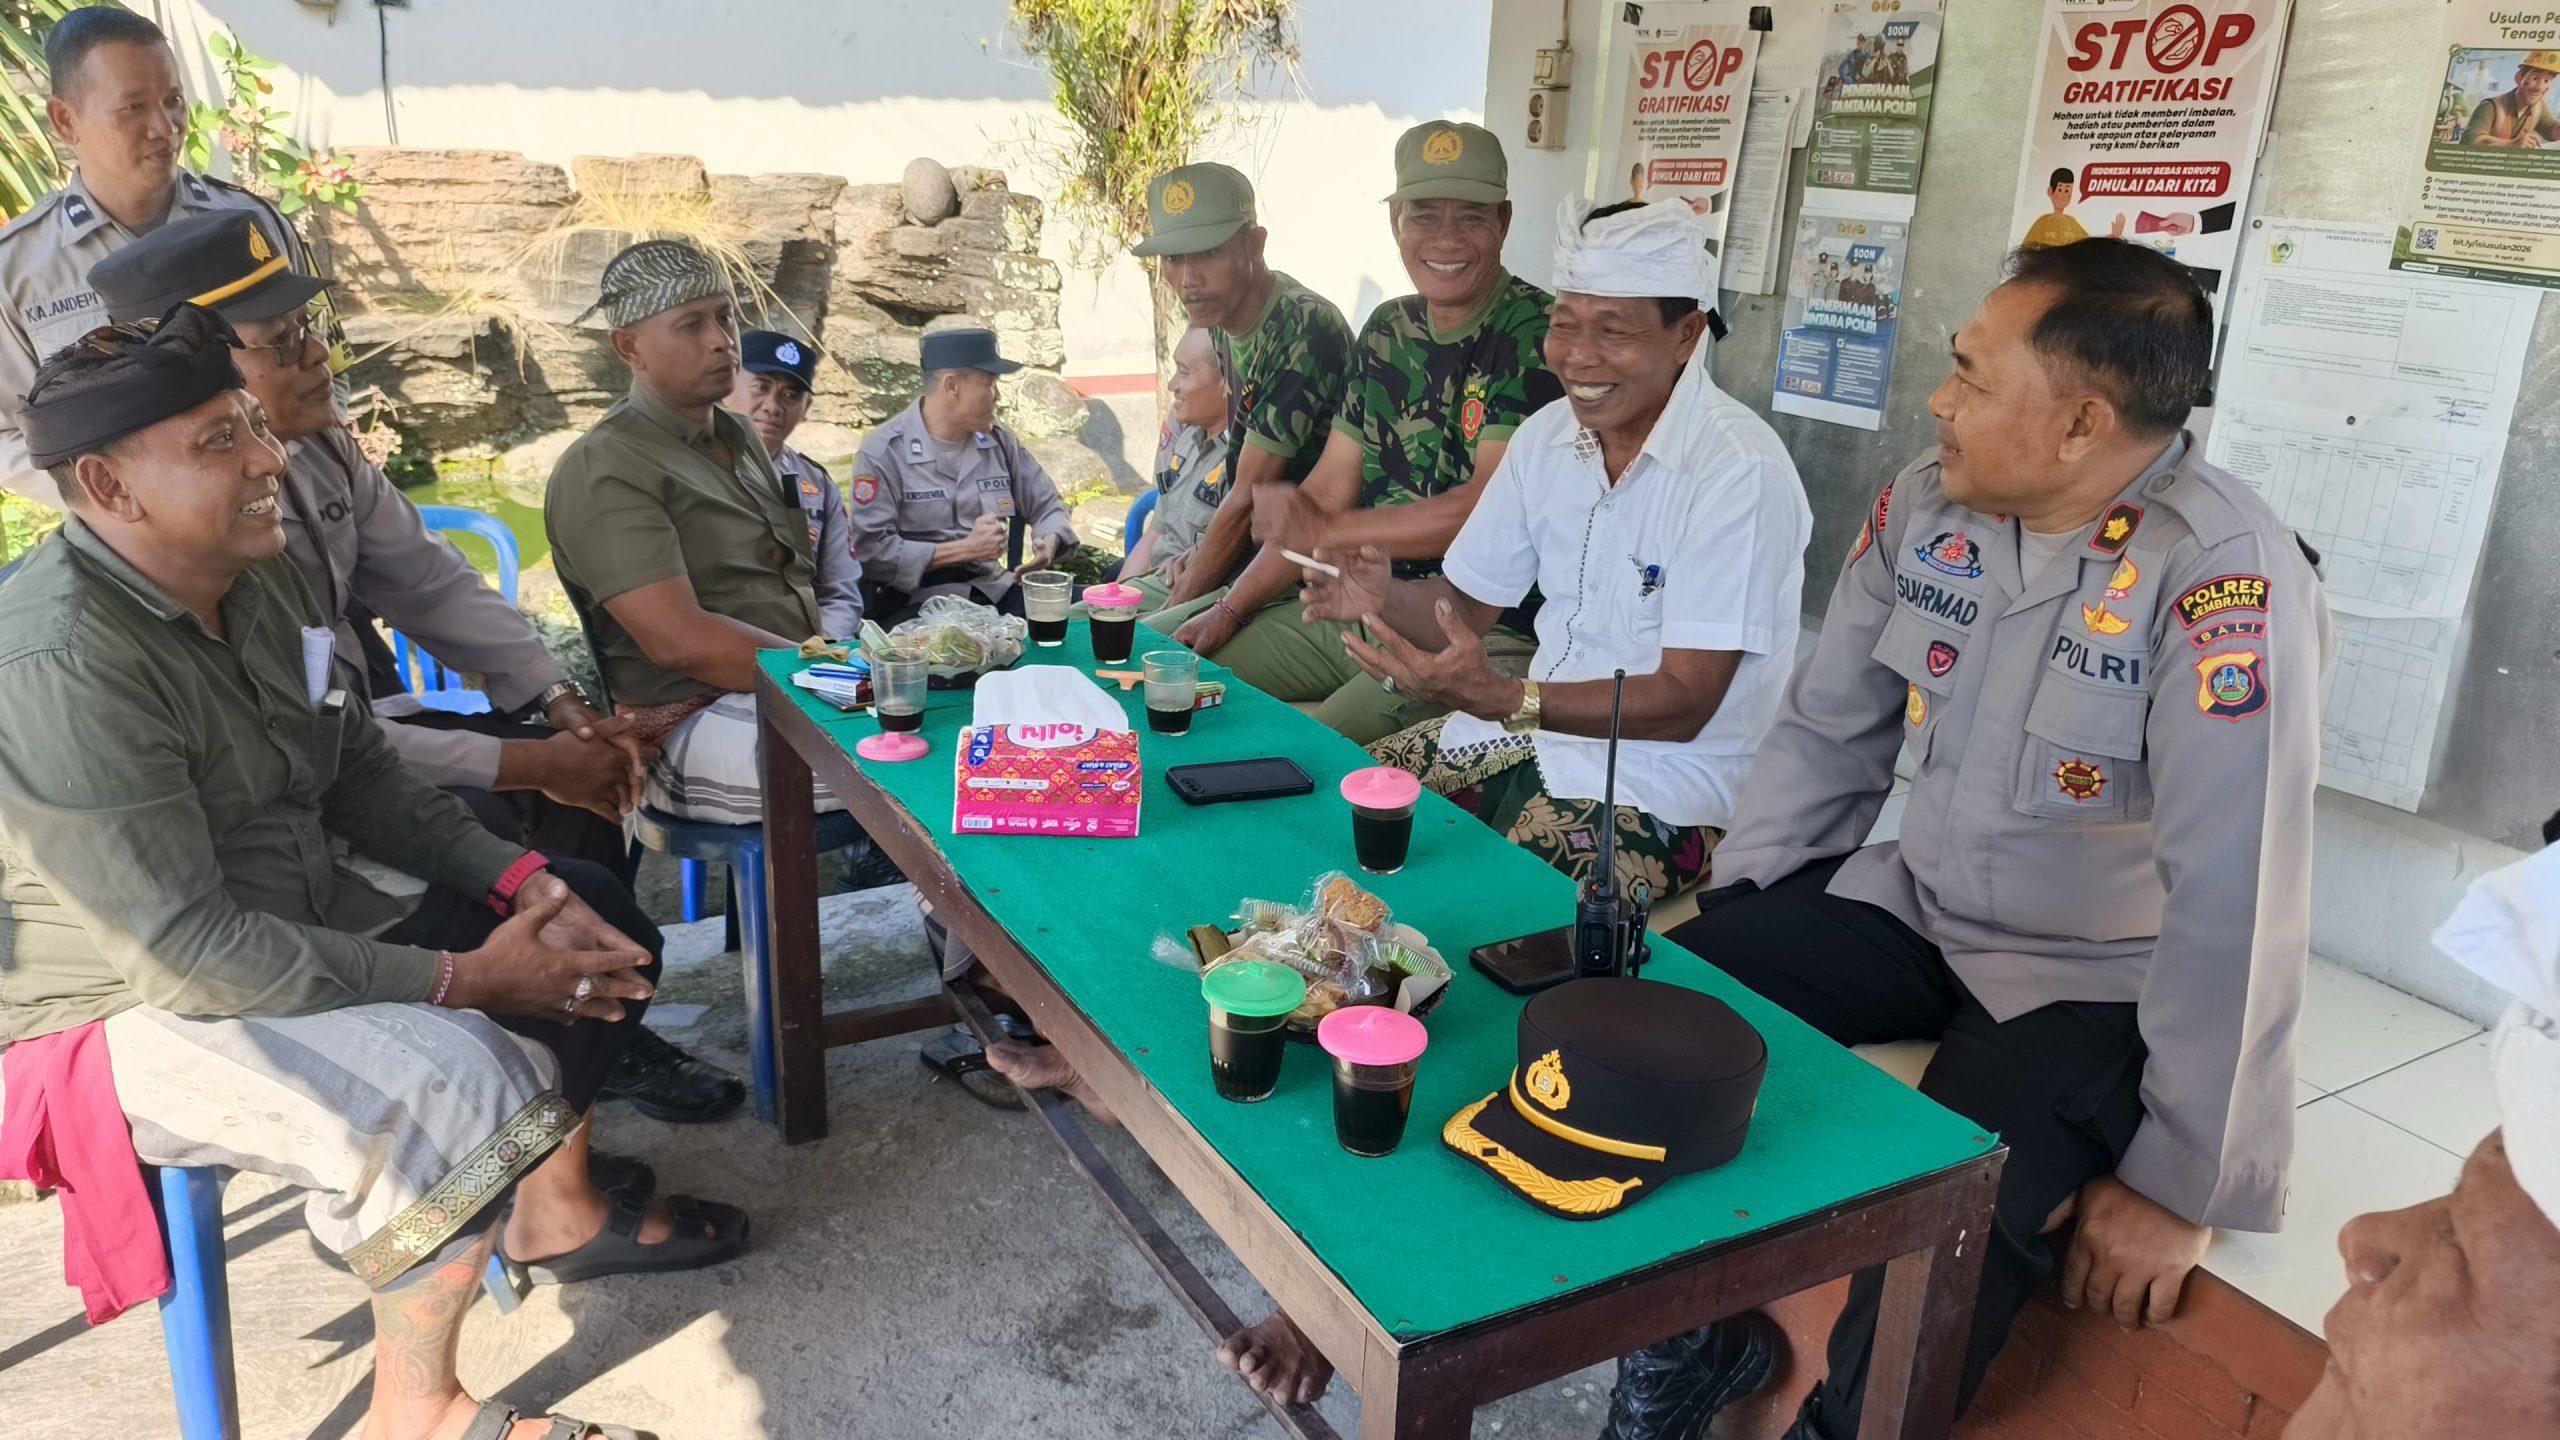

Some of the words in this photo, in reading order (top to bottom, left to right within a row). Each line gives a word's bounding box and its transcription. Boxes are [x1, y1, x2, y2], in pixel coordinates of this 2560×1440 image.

[2489, 11, 2541, 24] Usulan
[1887, 26, 1910, 36] SOON
[2500, 27, 2555, 42] Tenaga
[2067, 4, 2255, 74] STOP
[1640, 39, 1743, 92] STOP
[1842, 84, 1910, 97] PENERIMAAN
[2063, 77, 2233, 104] GRATIFIKASI
[1638, 95, 1731, 113] GRATIFIKASI
[1831, 100, 1882, 113] TAMTAMA
[1883, 101, 1917, 114] POLRI
[2053, 112, 2083, 120] Mohon
[2085, 111, 2112, 119] untuk
[2115, 109, 2139, 118] tidak
[2142, 108, 2186, 118] memberi
[2189, 107, 2236, 117] imbalan,
[2067, 121, 2099, 130] hadiah
[2101, 121, 2122, 129] atau
[2124, 120, 2179, 131] pemberian
[2182, 119, 2214, 128] dalam
[2062, 131, 2095, 140] bentuk
[2097, 131, 2132, 141] apapun
[2134, 130, 2157, 138] atas
[2158, 129, 2216, 140] pelayanan
[2089, 141, 2112, 151] yang
[2114, 140, 2138, 149] kami
[2140, 140, 2180, 149] berikan
[1683, 171, 1701, 181] DARI
[1702, 171, 1720, 181] KITA
[2091, 167, 2130, 175] INDONESIA
[2132, 167, 2153, 175] YANG
[2153, 166, 2181, 175] BEBAS
[2182, 166, 2220, 175] KORUPSI
[2088, 179, 2144, 192] DIMULAI
[2144, 179, 2181, 192] DARI
[2182, 179, 2217, 192] KITA
[2453, 238, 2532, 253] bit.ly/isiusulan2026
[1854, 248, 1876, 259] SOON
[1809, 300, 1876, 317] PENERIMAAN
[1802, 312, 1844, 329] BINTARA
[1845, 318, 1877, 334] POLRI
[2182, 580, 2265, 611] POLRES
[2191, 595, 2259, 620] JEMBRANA
[2201, 623, 2255, 641] BALI
[2052, 635, 2139, 684] POLRI
